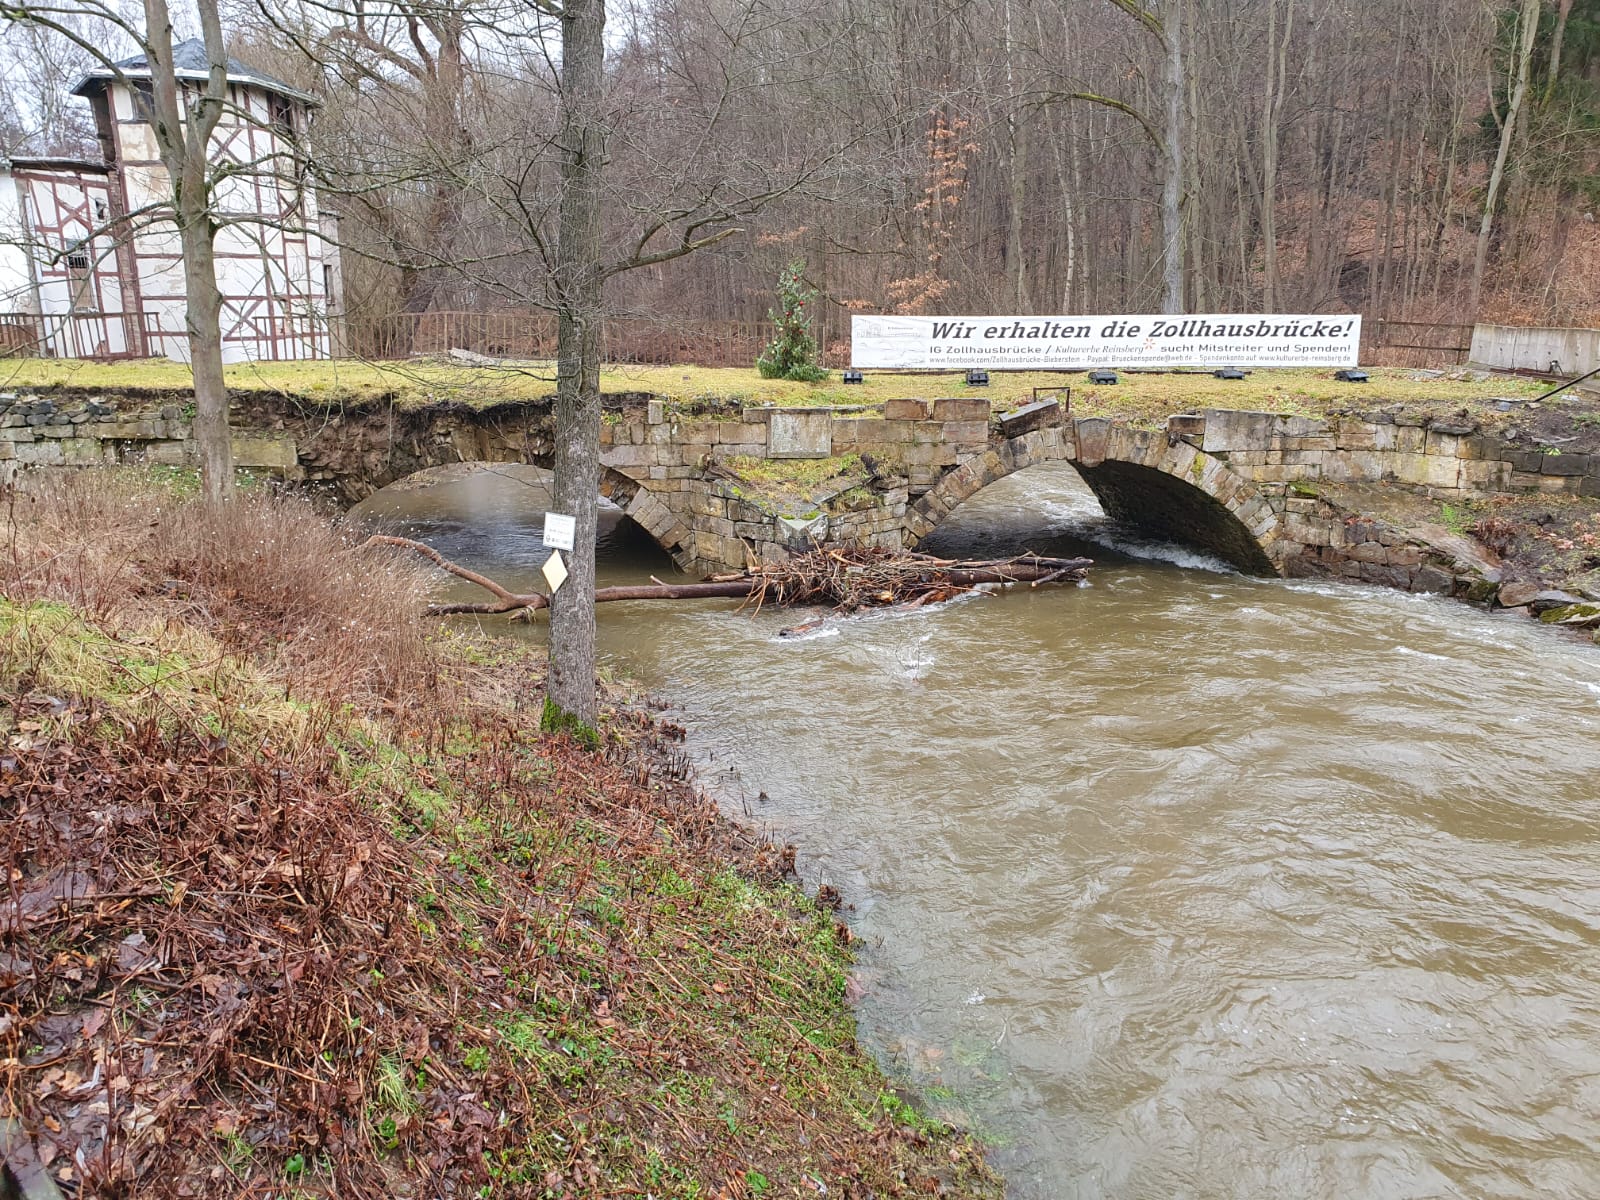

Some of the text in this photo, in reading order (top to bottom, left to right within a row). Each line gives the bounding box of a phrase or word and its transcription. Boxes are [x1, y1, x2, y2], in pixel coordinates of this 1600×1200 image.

[932, 320, 1353, 339] Wir erhalten die Zollhausbrücke!
[929, 344, 1351, 355] IG Zollhausbrücke / Kulturerbe Reinsberg sucht Mitstreiter und Spenden!
[1199, 354, 1244, 363] Spendenkonto
